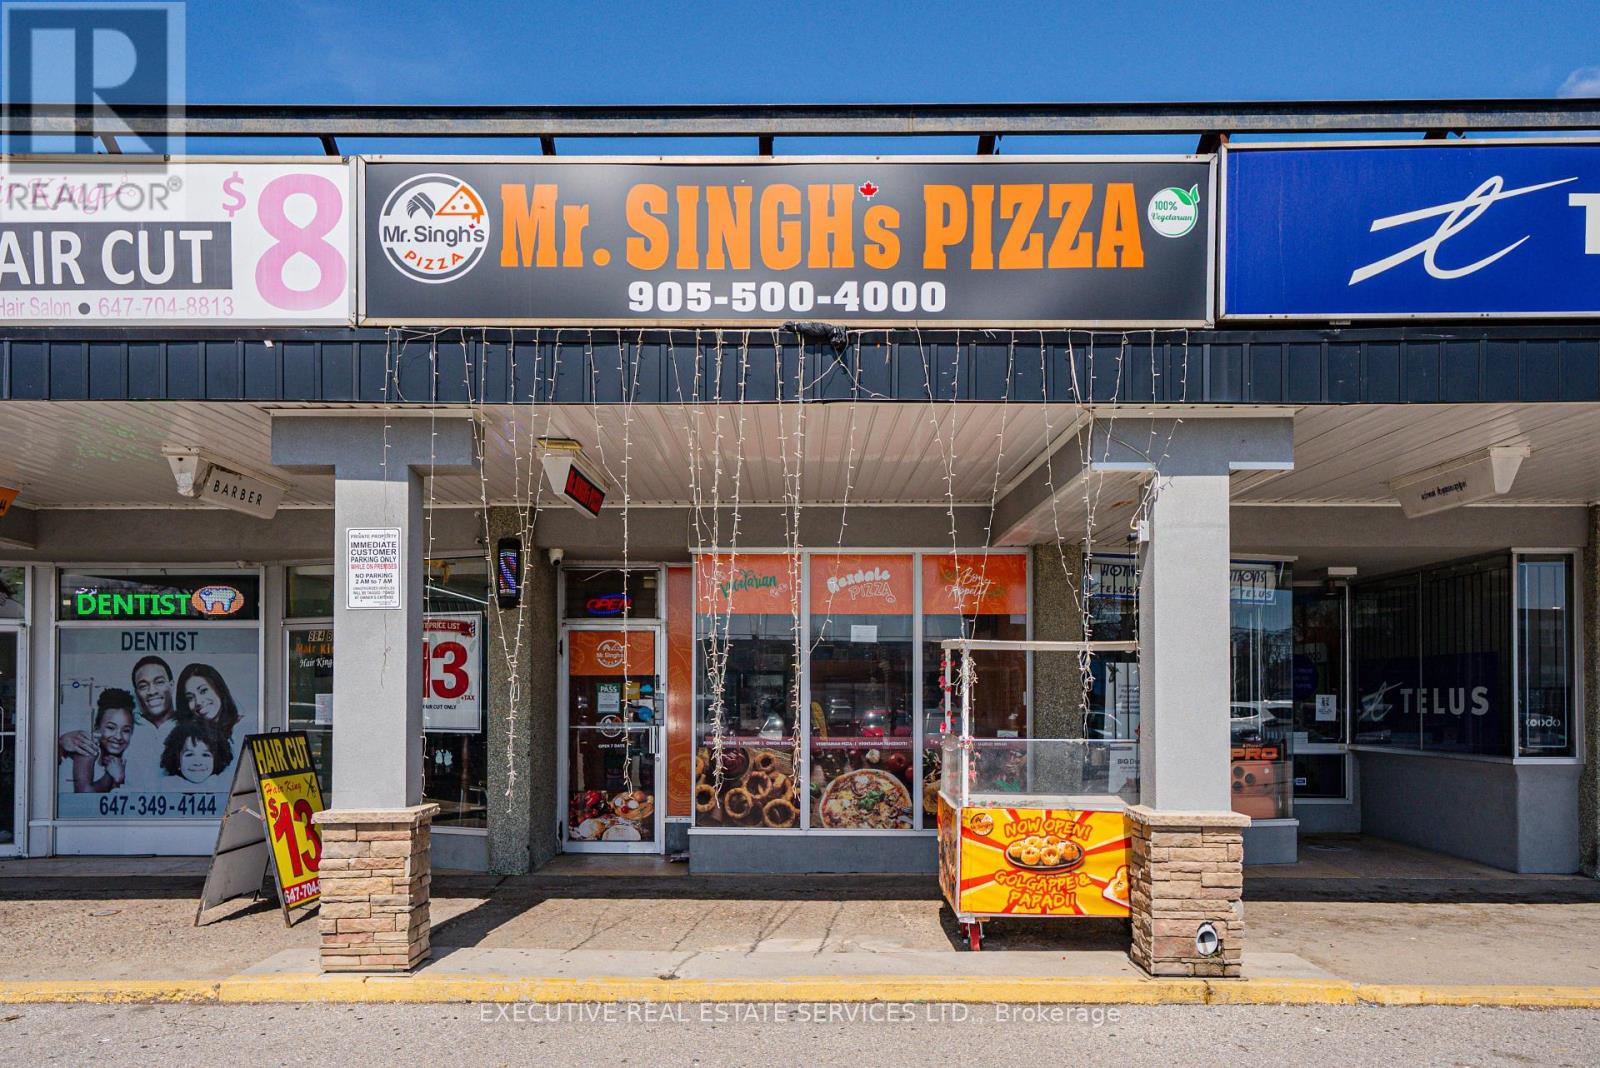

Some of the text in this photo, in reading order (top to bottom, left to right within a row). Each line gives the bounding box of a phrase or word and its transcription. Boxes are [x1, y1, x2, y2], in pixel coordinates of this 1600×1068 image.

[1155, 200, 1178, 211] 100%
[500, 183, 611, 268] Mr.
[922, 182, 1145, 271] PIZZA
[1152, 212, 1192, 222] Vegetarian
[383, 225, 411, 243] Mr.
[0, 229, 214, 286] AIR CUT
[403, 249, 465, 271] PIZZA
[29, 296, 72, 317] Salon
[98, 296, 234, 317] 647-704-8813
[627, 280, 946, 313] 905-500-4000
[213, 479, 263, 506] BARBER
[350, 541, 397, 549] IMMEDIATE
[848, 582, 892, 602] PIZZA
[77, 593, 192, 615] DENTIST
[447, 622, 461, 630] LIST
[121, 631, 199, 651] DENTIST
[1400, 686, 1490, 717] TELUS
[252, 736, 311, 775] HAIR CUT
[1231, 747, 1278, 761] PRO
[264, 779, 303, 796] Hair King
[99, 795, 217, 816] 647-349-4144
[1005, 818, 1042, 838] NOW
[1044, 818, 1093, 840] OPEN!
[995, 869, 1092, 892] GOLGAPPE &
